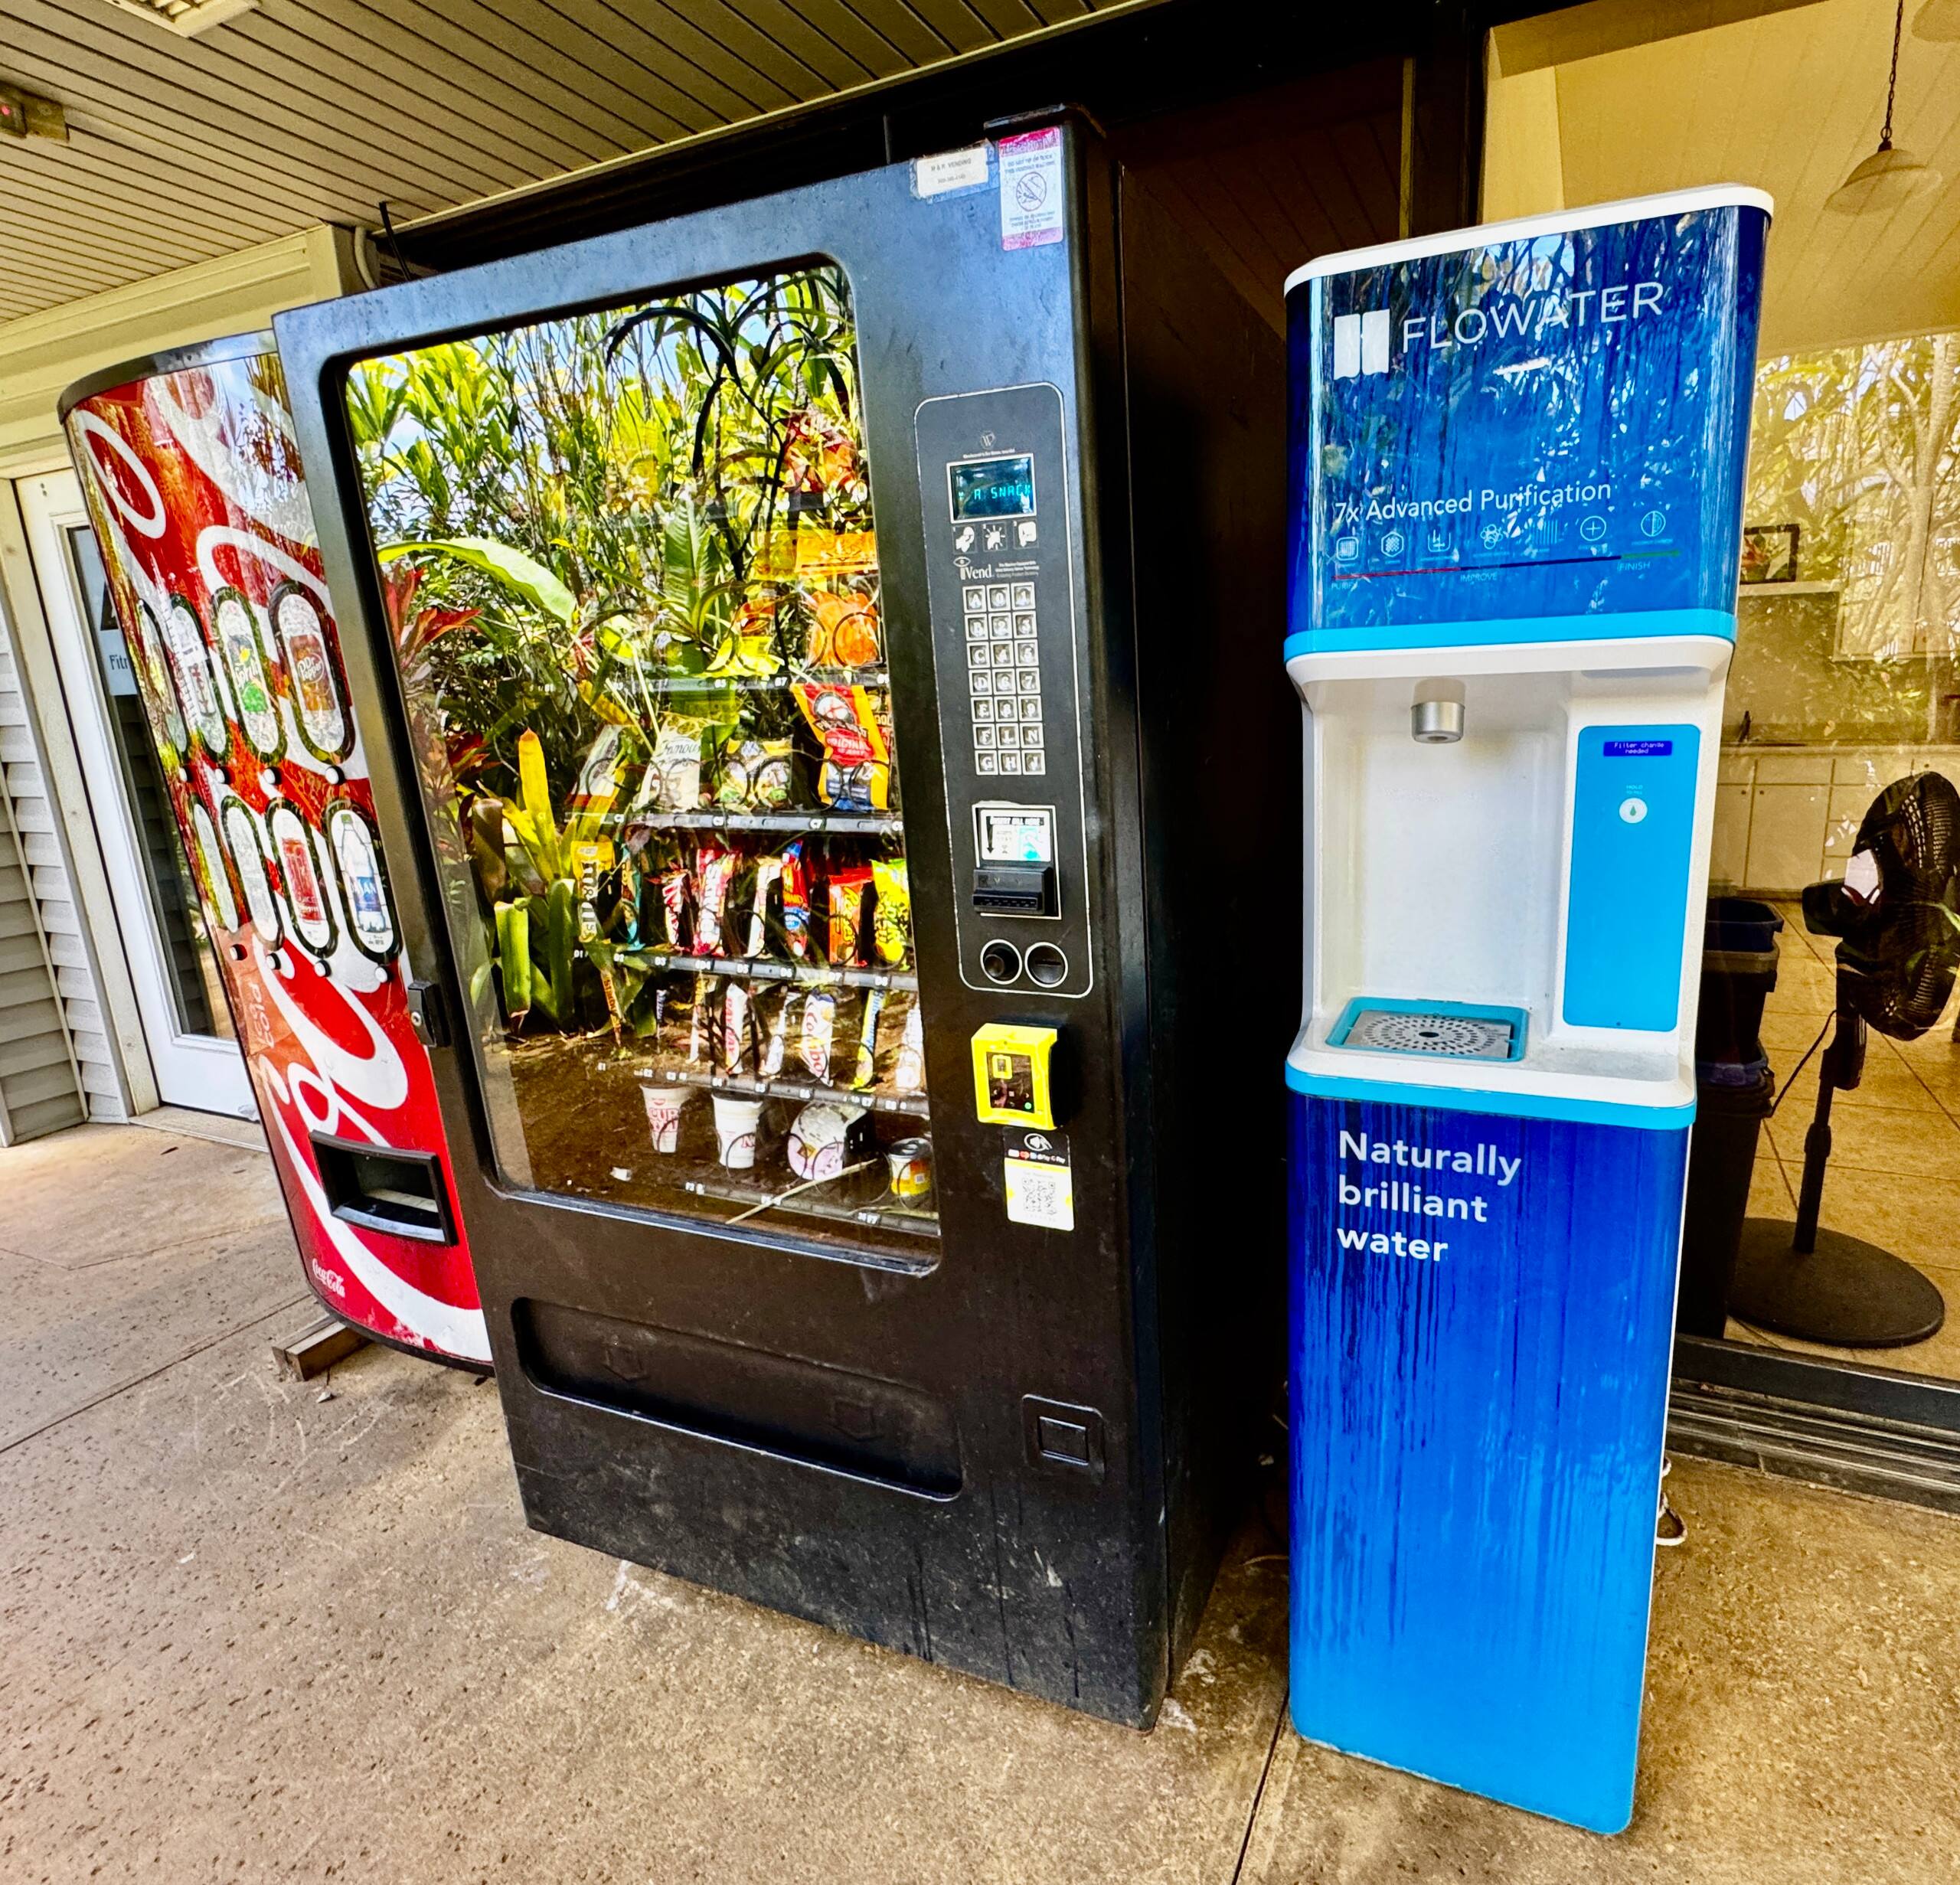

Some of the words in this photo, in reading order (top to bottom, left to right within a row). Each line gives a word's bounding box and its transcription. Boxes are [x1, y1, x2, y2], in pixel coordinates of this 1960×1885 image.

[1402, 281, 1664, 354] FLOWATER
[990, 483, 1031, 499] SNACK
[1334, 501, 1359, 524] 7x
[1366, 492, 1473, 521] Advanced
[1480, 481, 1612, 511] Purification
[1460, 573, 1498, 583] IMPROVE
[1618, 561, 1651, 572] FINISH
[1339, 1130, 1522, 1187] Naturally
[1338, 1174, 1488, 1223] brilliant
[1336, 1227, 1449, 1262] water
